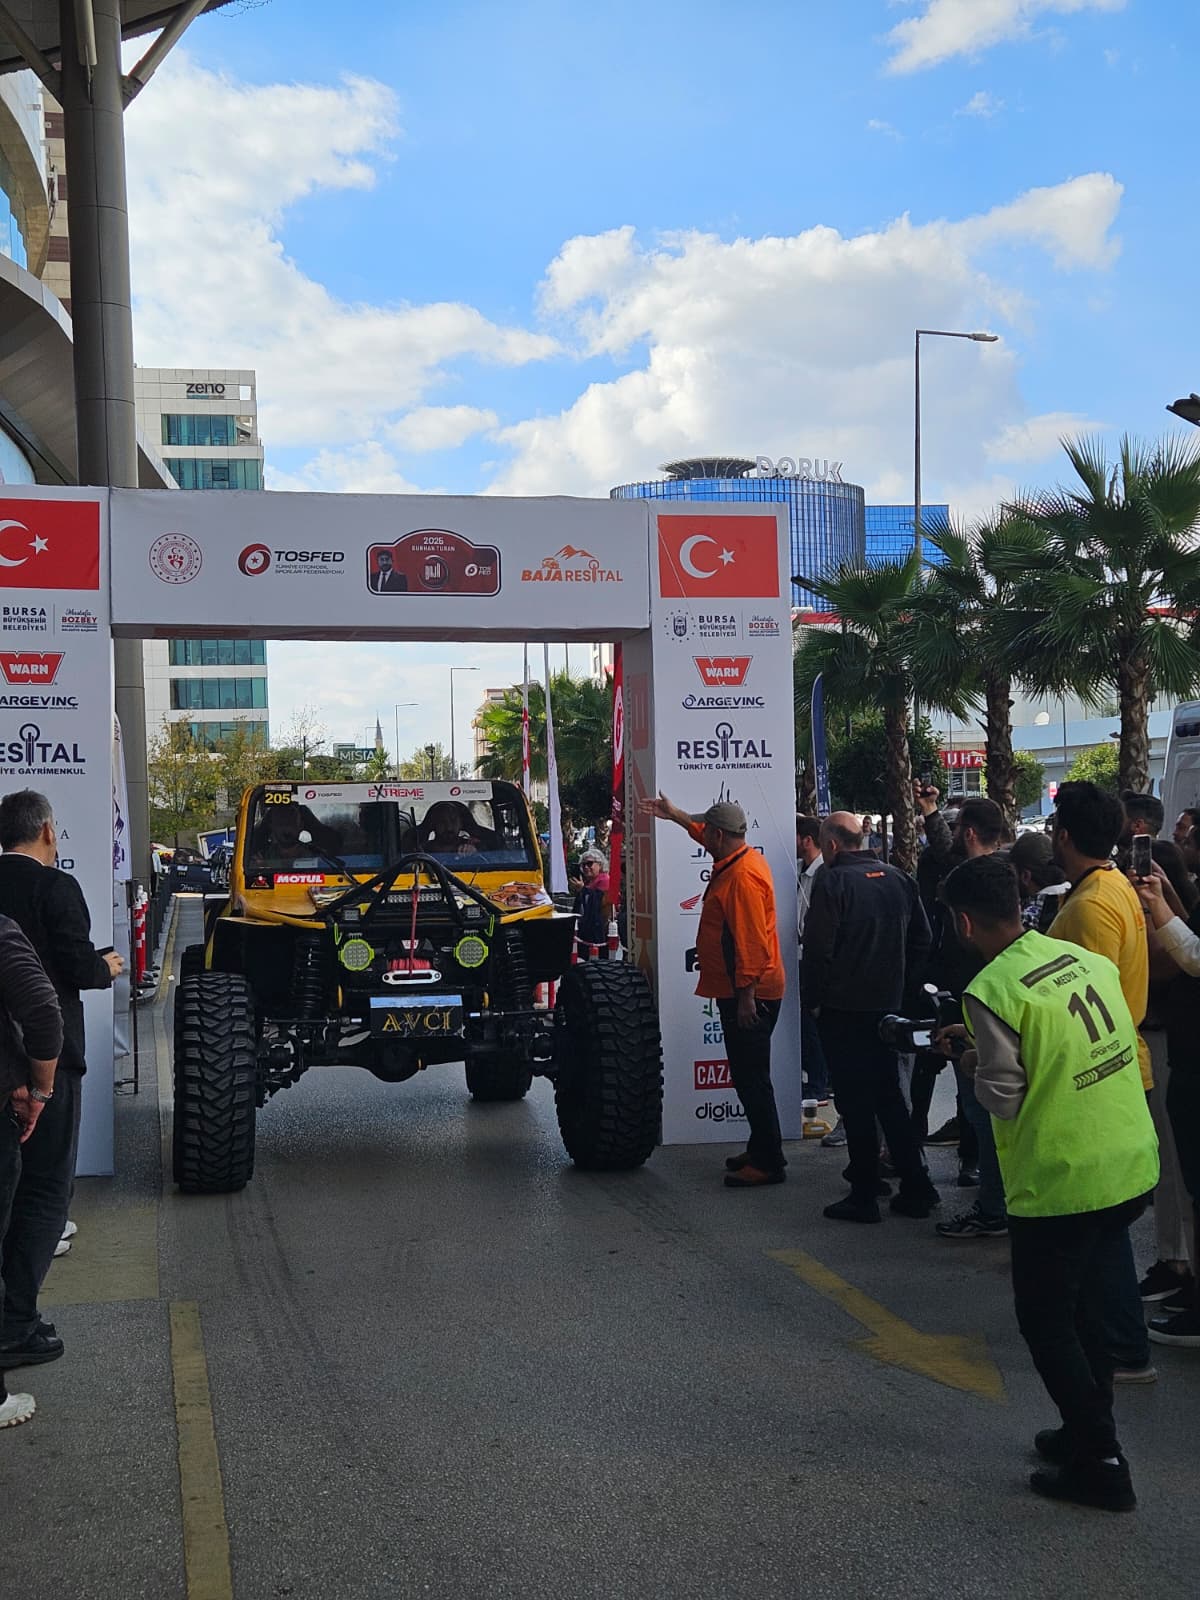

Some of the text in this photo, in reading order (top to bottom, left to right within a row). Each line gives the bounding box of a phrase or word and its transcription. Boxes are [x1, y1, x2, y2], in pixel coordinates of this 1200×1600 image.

[186, 383, 225, 394] zeno
[756, 456, 843, 482] DORUK
[275, 551, 344, 563] TOSFED
[3, 607, 46, 616] BURSA
[699, 615, 736, 624] BURSA
[9, 664, 48, 674] WARN
[705, 668, 739, 677] WARN
[18, 767, 86, 775] GAYRİMENKUL
[715, 762, 772, 770] GAYRİMENKUL
[368, 784, 424, 800] EXTREME
[265, 793, 290, 804] 205
[277, 875, 323, 883] MOTUL
[1067, 984, 1116, 1044] 11
